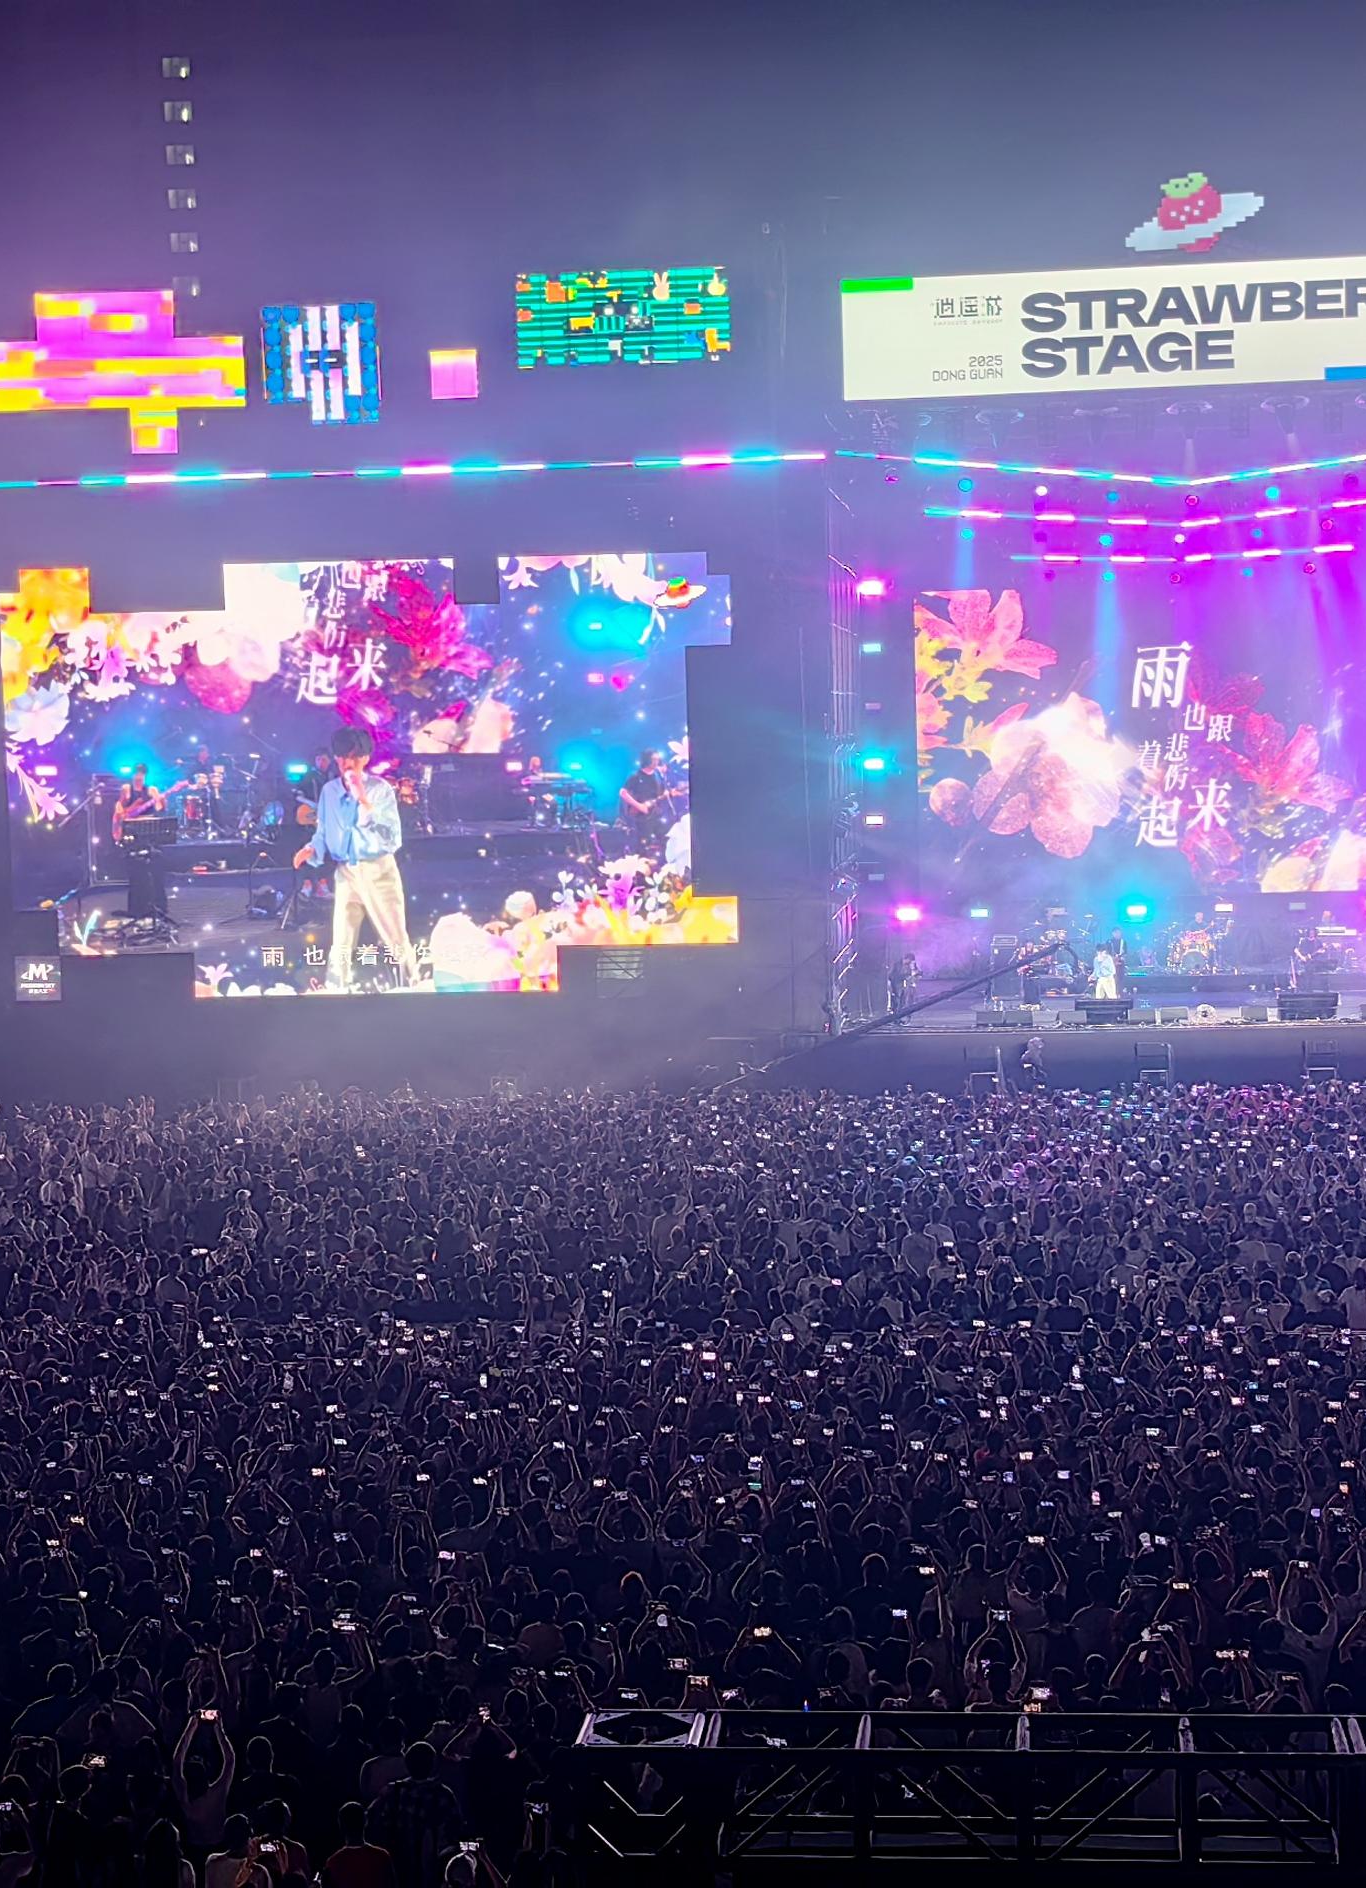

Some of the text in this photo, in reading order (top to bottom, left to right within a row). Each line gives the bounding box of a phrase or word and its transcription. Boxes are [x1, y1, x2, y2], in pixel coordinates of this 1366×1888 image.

[969, 355, 1003, 368] 2025
[1021, 329, 1235, 378] STAGE
[932, 368, 1003, 381] DONG GUAN
[1131, 640, 1193, 708] 雨
[261, 946, 285, 968] 雨
